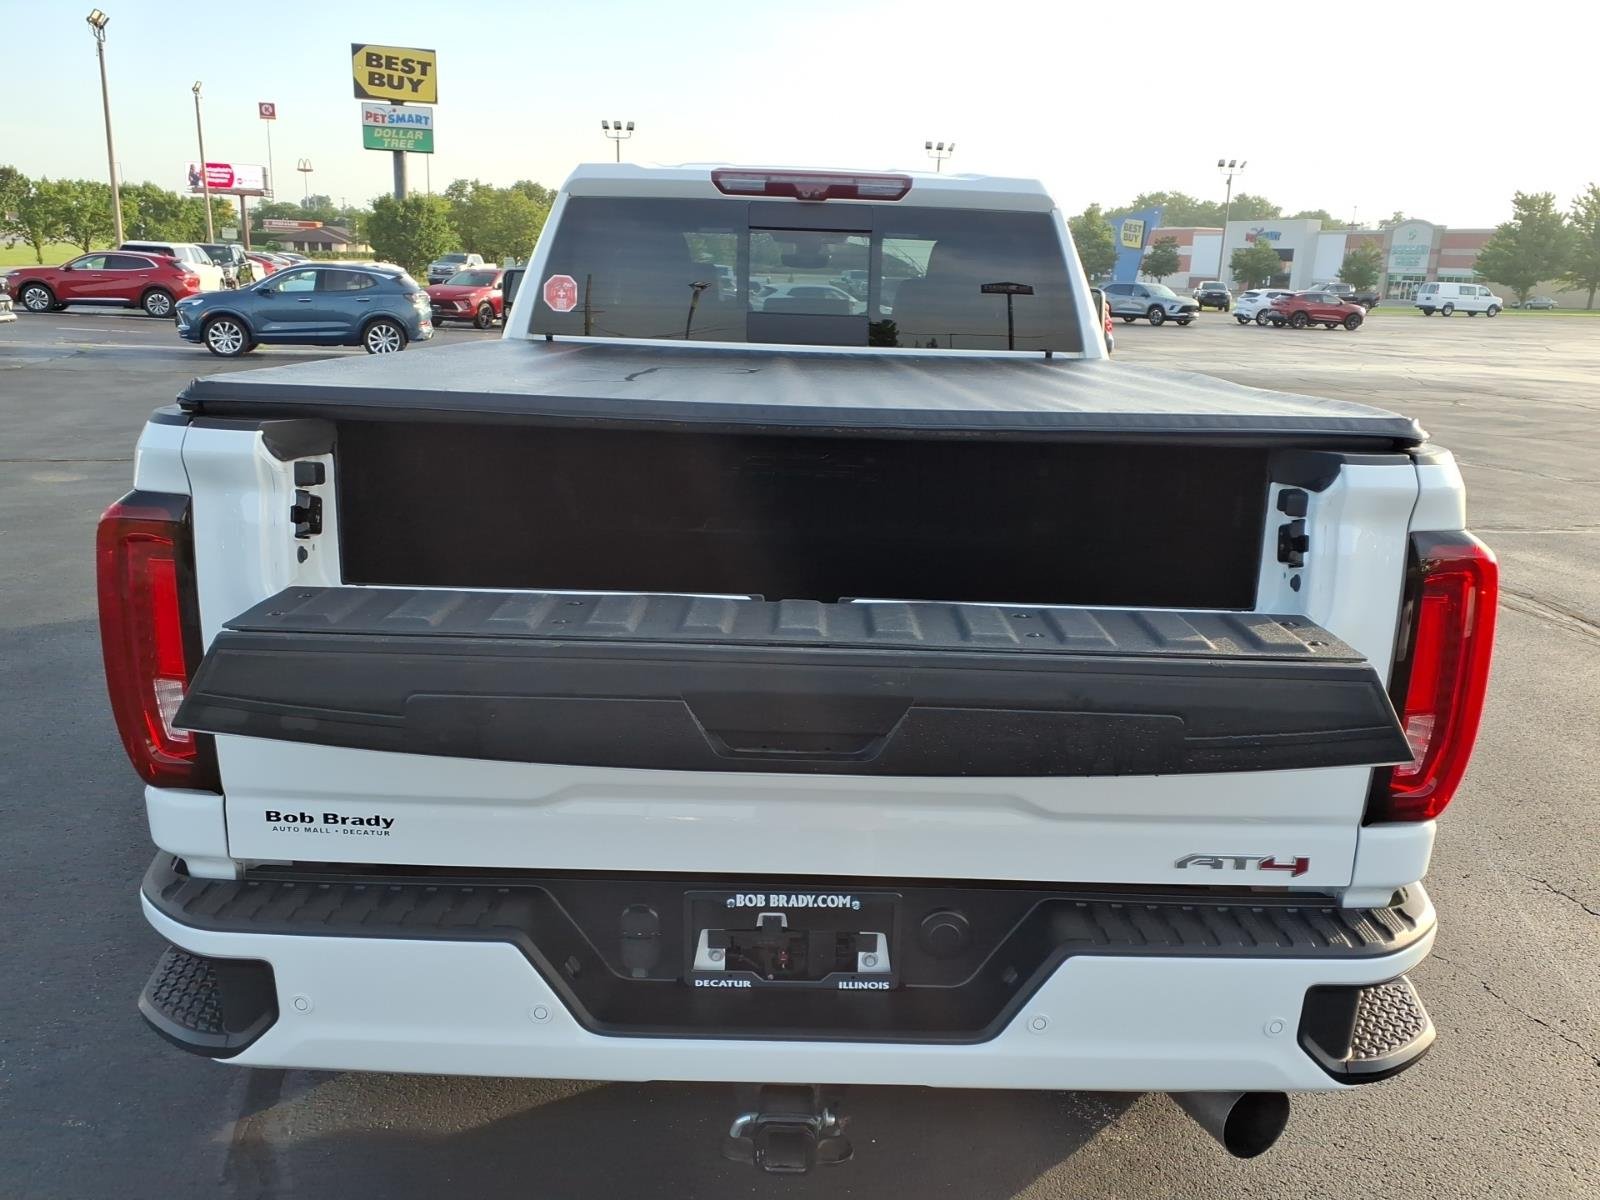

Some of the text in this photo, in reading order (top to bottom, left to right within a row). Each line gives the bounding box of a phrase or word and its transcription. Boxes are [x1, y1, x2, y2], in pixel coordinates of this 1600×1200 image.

[365, 52, 432, 76] BEST
[368, 71, 425, 93] BUY
[365, 110, 430, 125] PETSMART
[374, 128, 424, 140] DOLLAR
[383, 138, 416, 149] TREE
[1123, 222, 1142, 233] BEST
[1123, 232, 1139, 243] BUY
[265, 810, 395, 830] Bob Brady
[271, 825, 300, 833] AUTO
[342, 828, 391, 837] DECATUR
[1175, 853, 1311, 878] AT4
[735, 893, 851, 909] BOB BRADY.COM
[694, 979, 890, 991] DECATUR ILLINOIS
